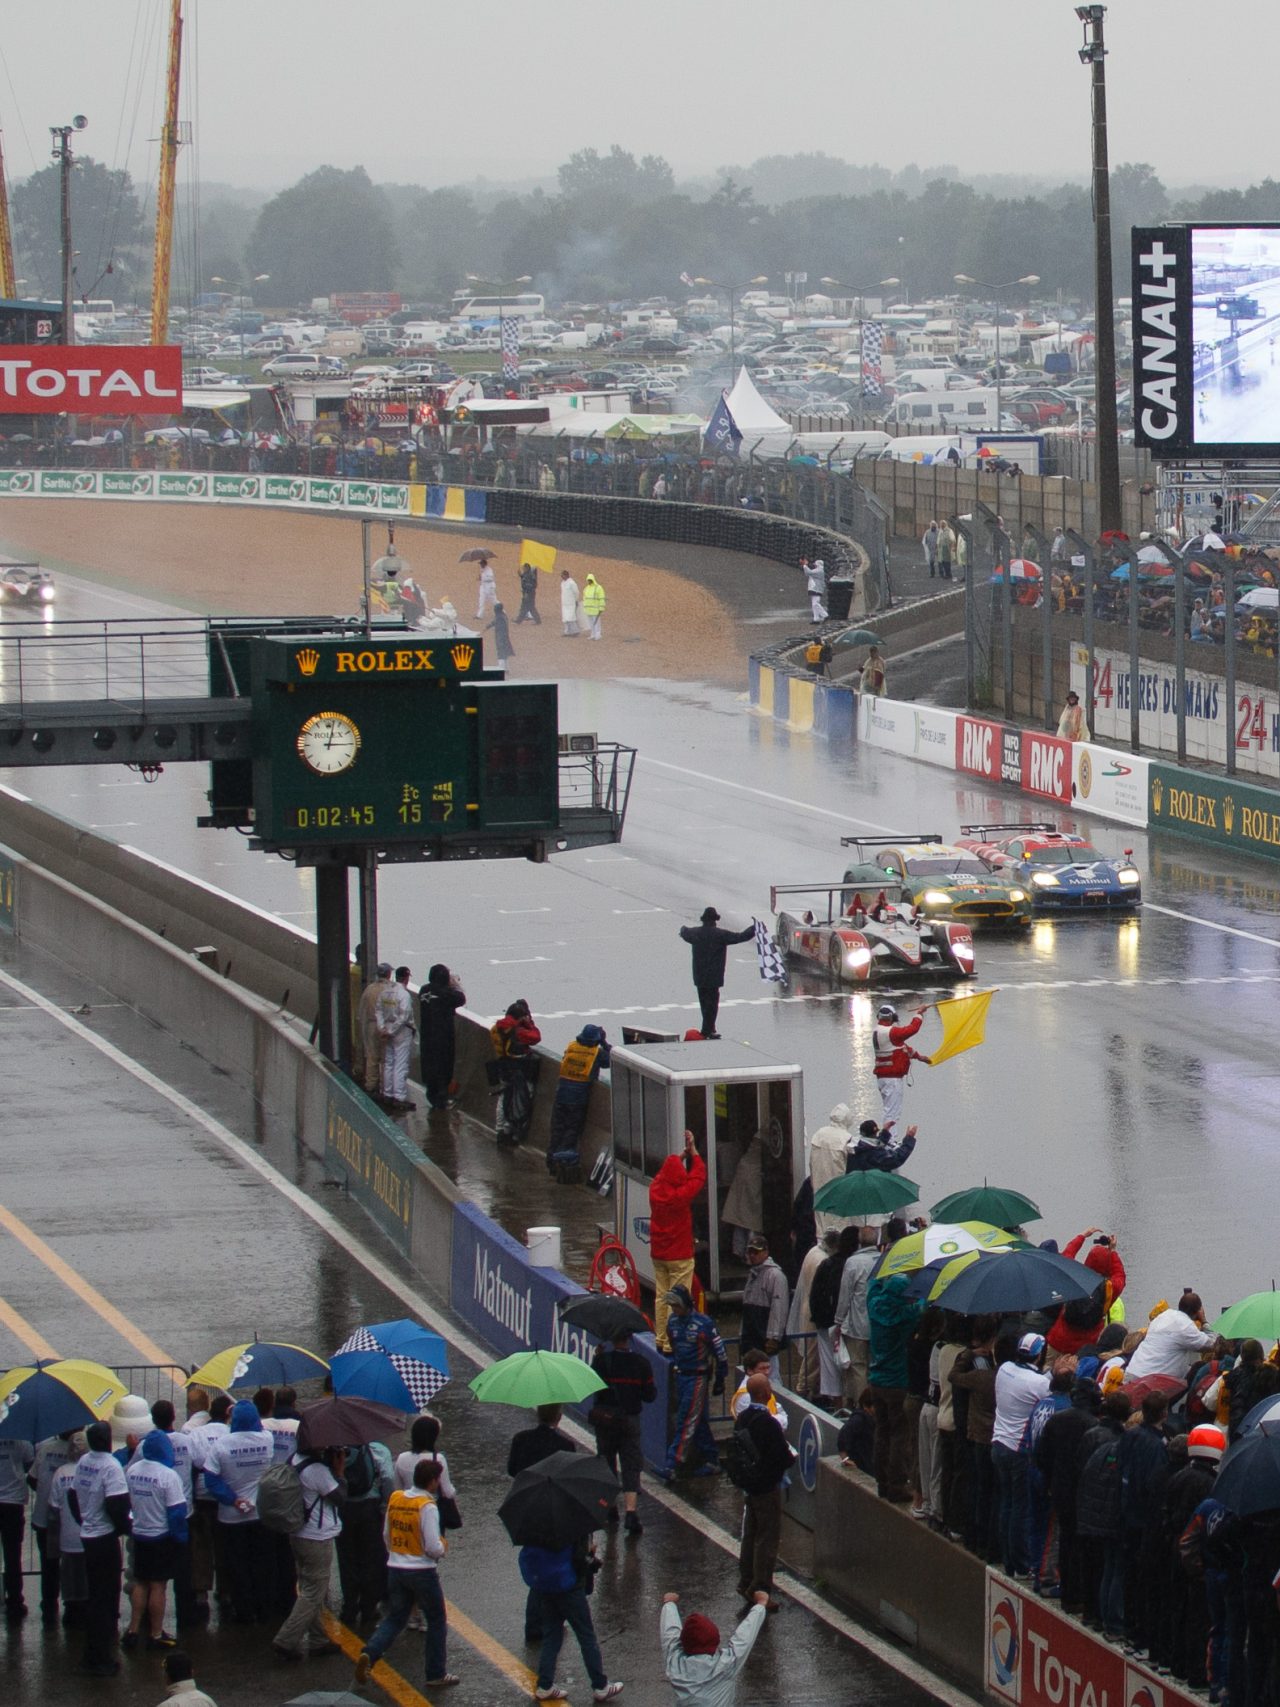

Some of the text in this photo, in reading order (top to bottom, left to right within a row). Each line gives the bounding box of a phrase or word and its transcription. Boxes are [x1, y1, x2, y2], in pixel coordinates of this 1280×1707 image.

[38, 323, 51, 335] 23
[1139, 241, 1178, 440] CANAL+
[0, 360, 177, 397] TOTAL
[44, 477, 71, 489] Sarthe
[105, 479, 131, 490] Sarthe
[161, 480, 186, 492] Sarthe
[216, 482, 239, 493] Sarthe
[267, 483, 289, 496] Sarthe
[336, 649, 435, 673] ROLEX
[1117, 673, 1158, 712] HERES
[1235, 694, 1267, 751] 24
[963, 721, 992, 775] RMC
[1004, 734, 1019, 751] INFO
[1004, 749, 1019, 767] TALK
[1001, 763, 1021, 783] SPORT
[1030, 741, 1064, 797] RMC
[298, 803, 453, 827] 0:02:45 15 7
[1169, 787, 1217, 828] ROLEX
[846, 940, 864, 948] TDI
[953, 935, 972, 944] TDI
[473, 1242, 532, 1346] Matmut
[230, 1446, 267, 1455] WINNER
